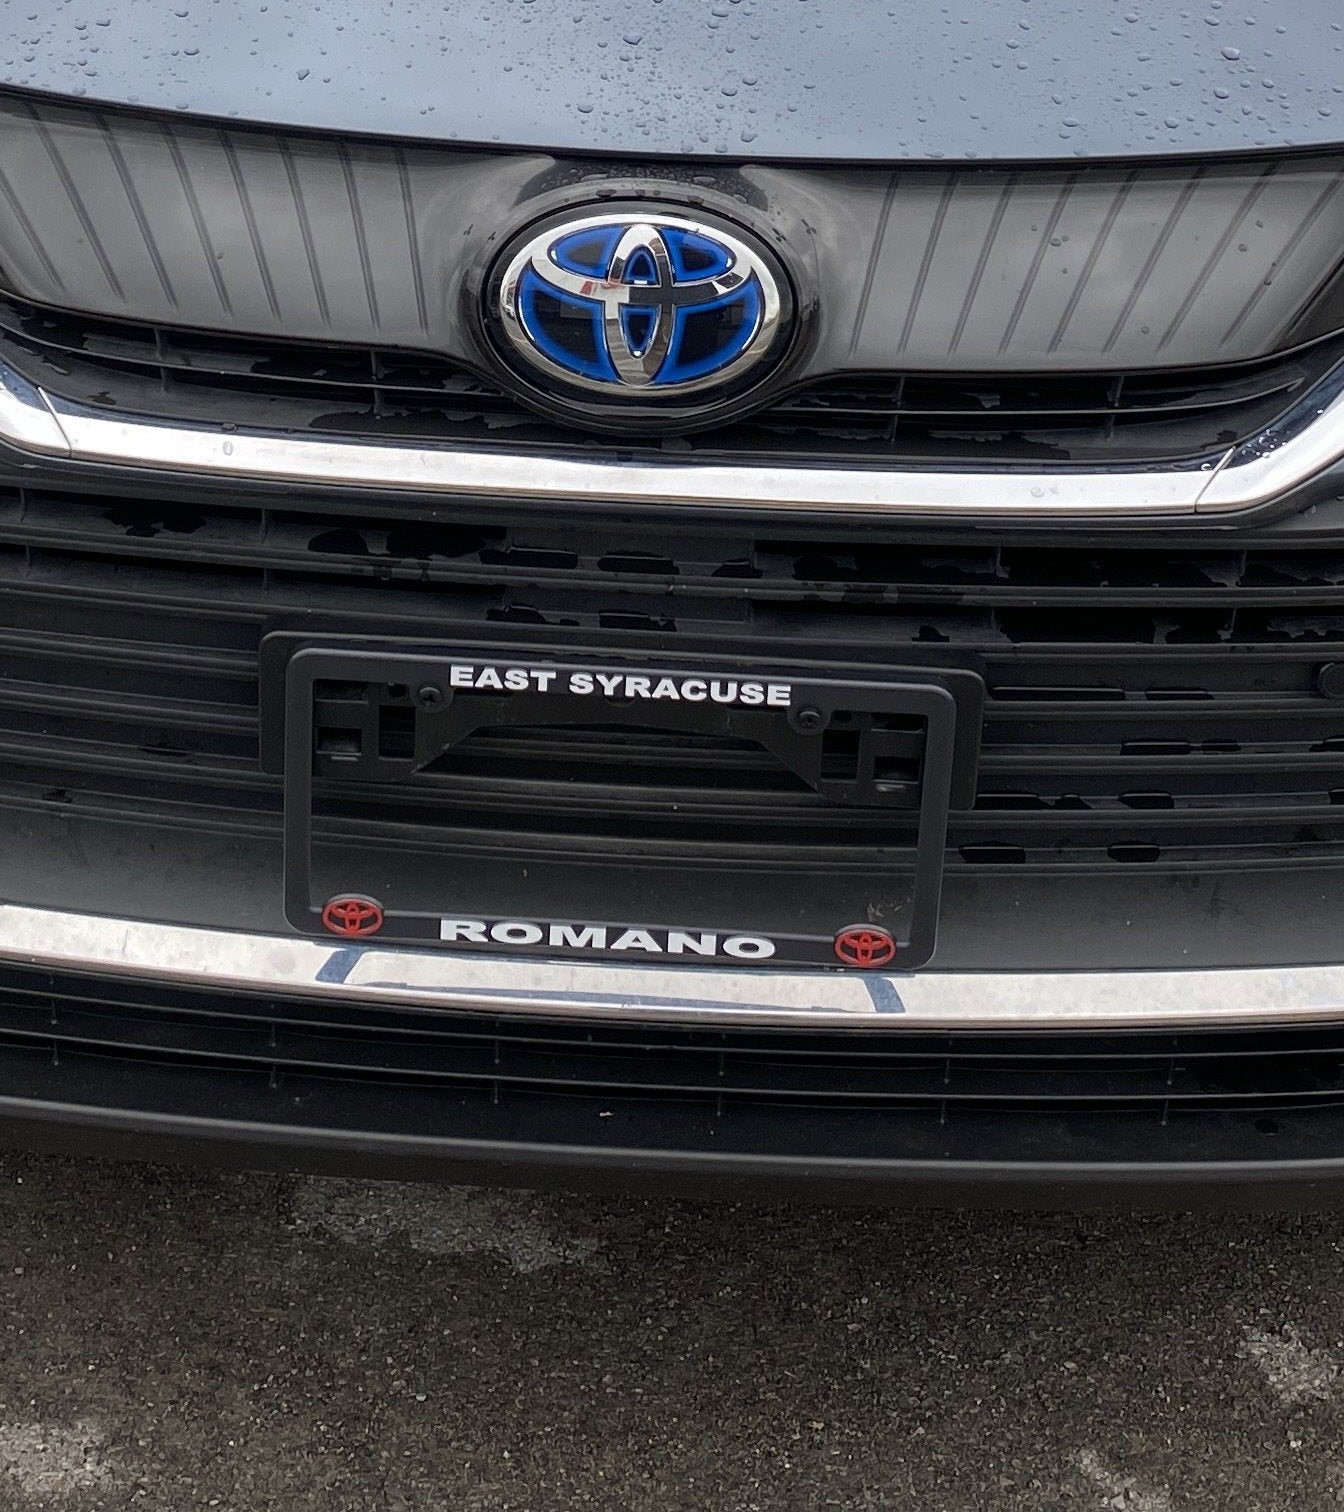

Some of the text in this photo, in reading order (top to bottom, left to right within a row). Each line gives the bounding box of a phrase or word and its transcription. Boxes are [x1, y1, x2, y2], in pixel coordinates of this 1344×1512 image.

[449, 664, 792, 707] EAST SYRACUSE
[439, 916, 777, 960] ROMANO
